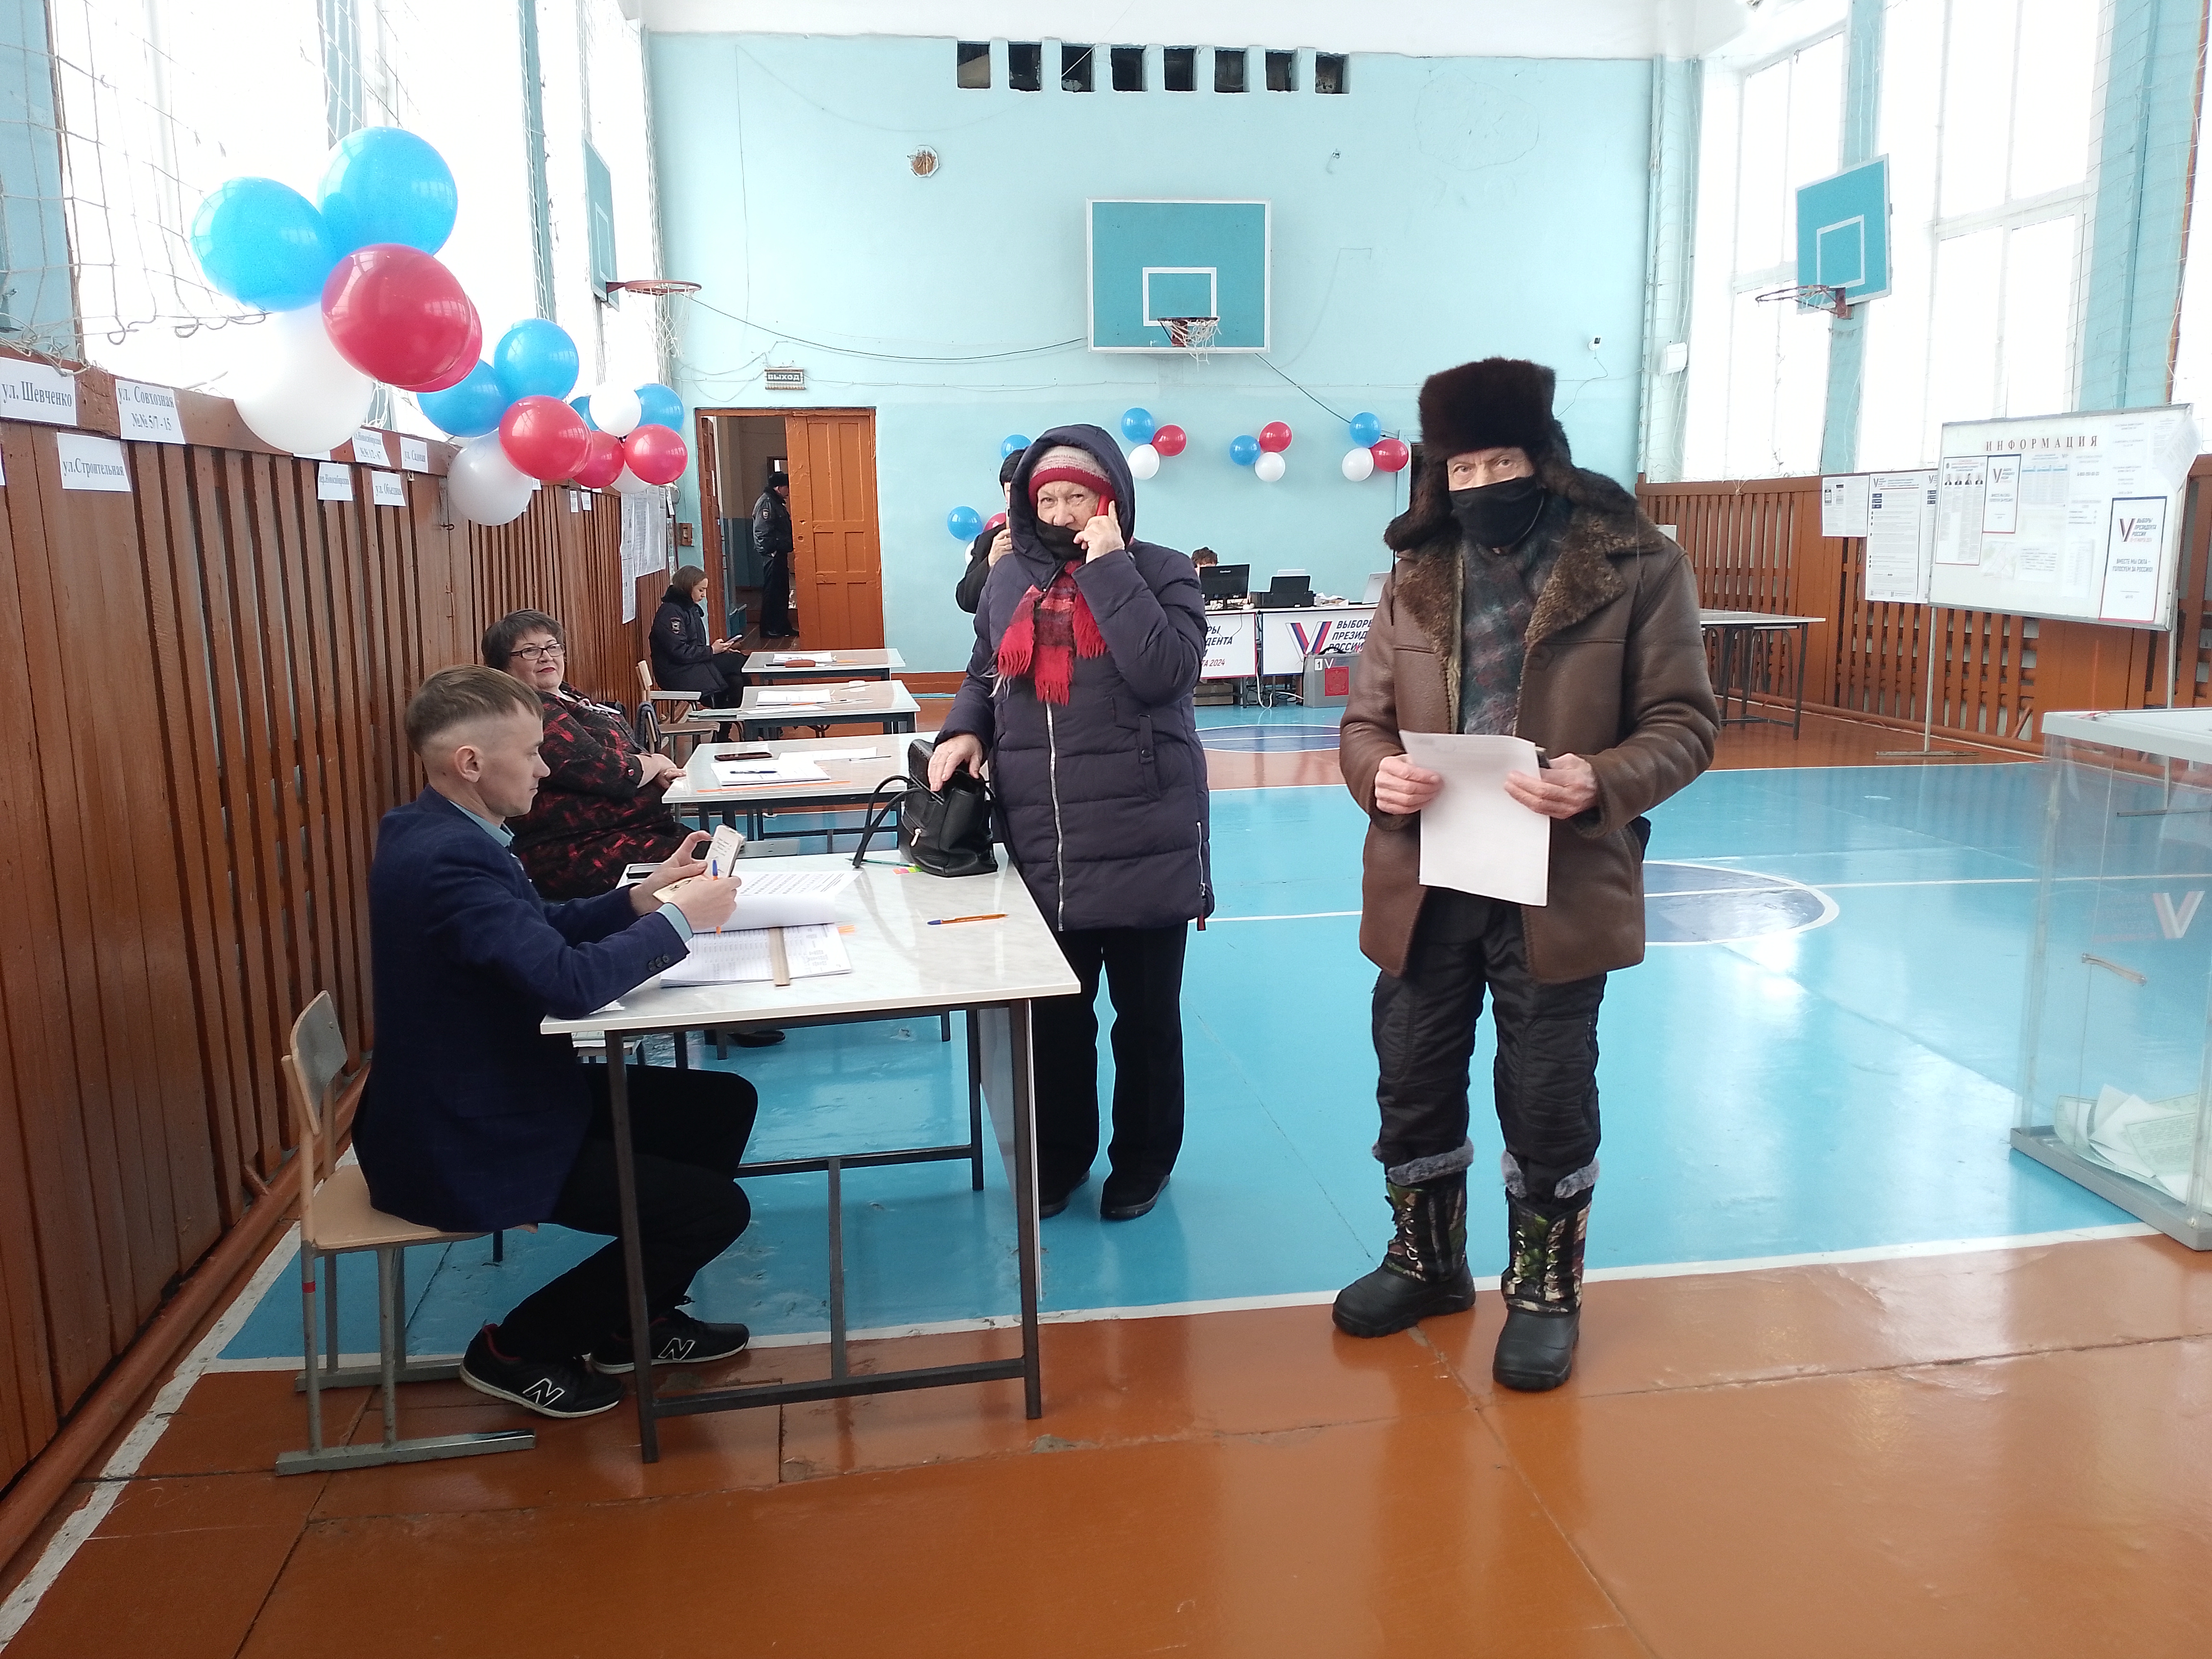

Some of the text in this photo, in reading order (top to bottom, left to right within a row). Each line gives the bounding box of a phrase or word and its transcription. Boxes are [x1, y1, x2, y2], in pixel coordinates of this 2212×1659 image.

[1, 381, 72, 407] ул. Шевченко
[118, 385, 175, 408] ул. Совхозная
[1986, 435, 2098, 451] ИНФОРМАЦИЯ
[1209, 659, 1225, 667] 2024
